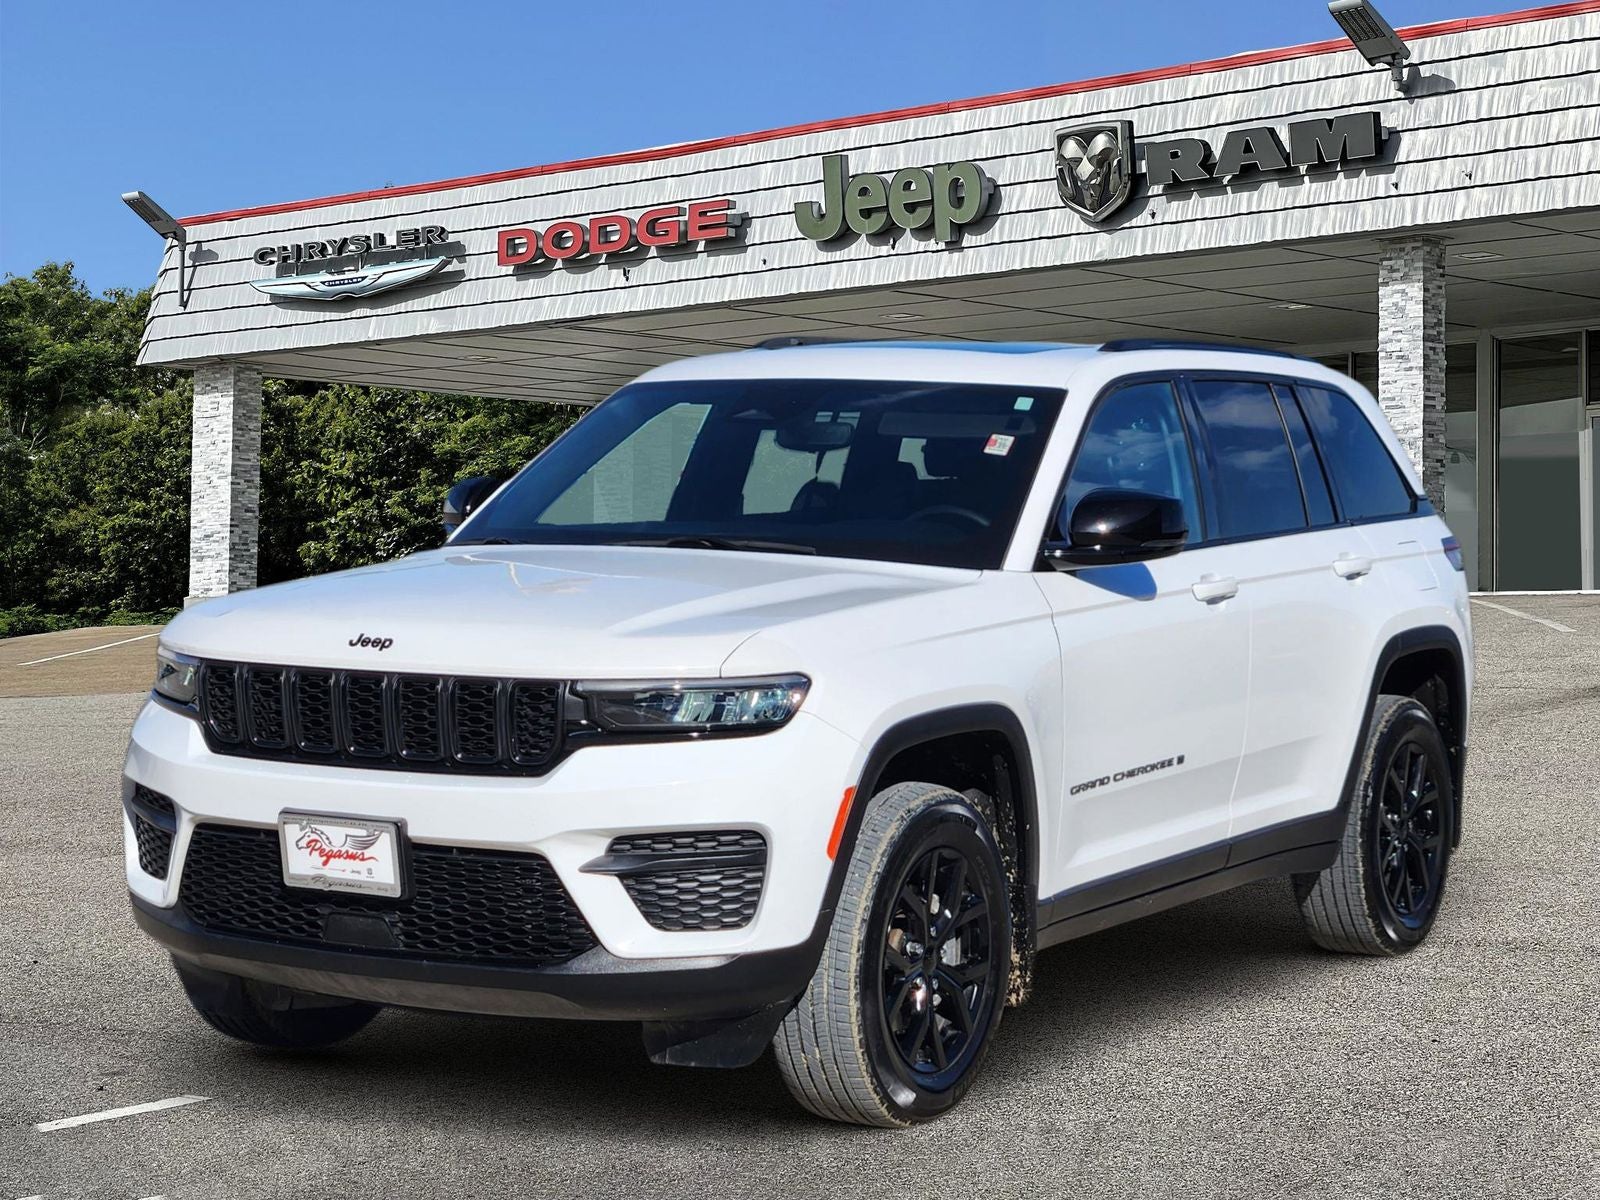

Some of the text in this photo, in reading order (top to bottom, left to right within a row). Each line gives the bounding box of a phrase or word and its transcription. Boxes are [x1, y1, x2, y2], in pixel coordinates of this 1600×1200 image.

[1145, 112, 1381, 186] RAM
[795, 155, 988, 242] Jeep
[254, 225, 449, 266] CHRYSLER
[498, 199, 735, 266] DODGE
[348, 633, 393, 651] Jeep
[1070, 758, 1175, 796] GRAND CHEROKEE
[306, 838, 379, 867] Pegasus
